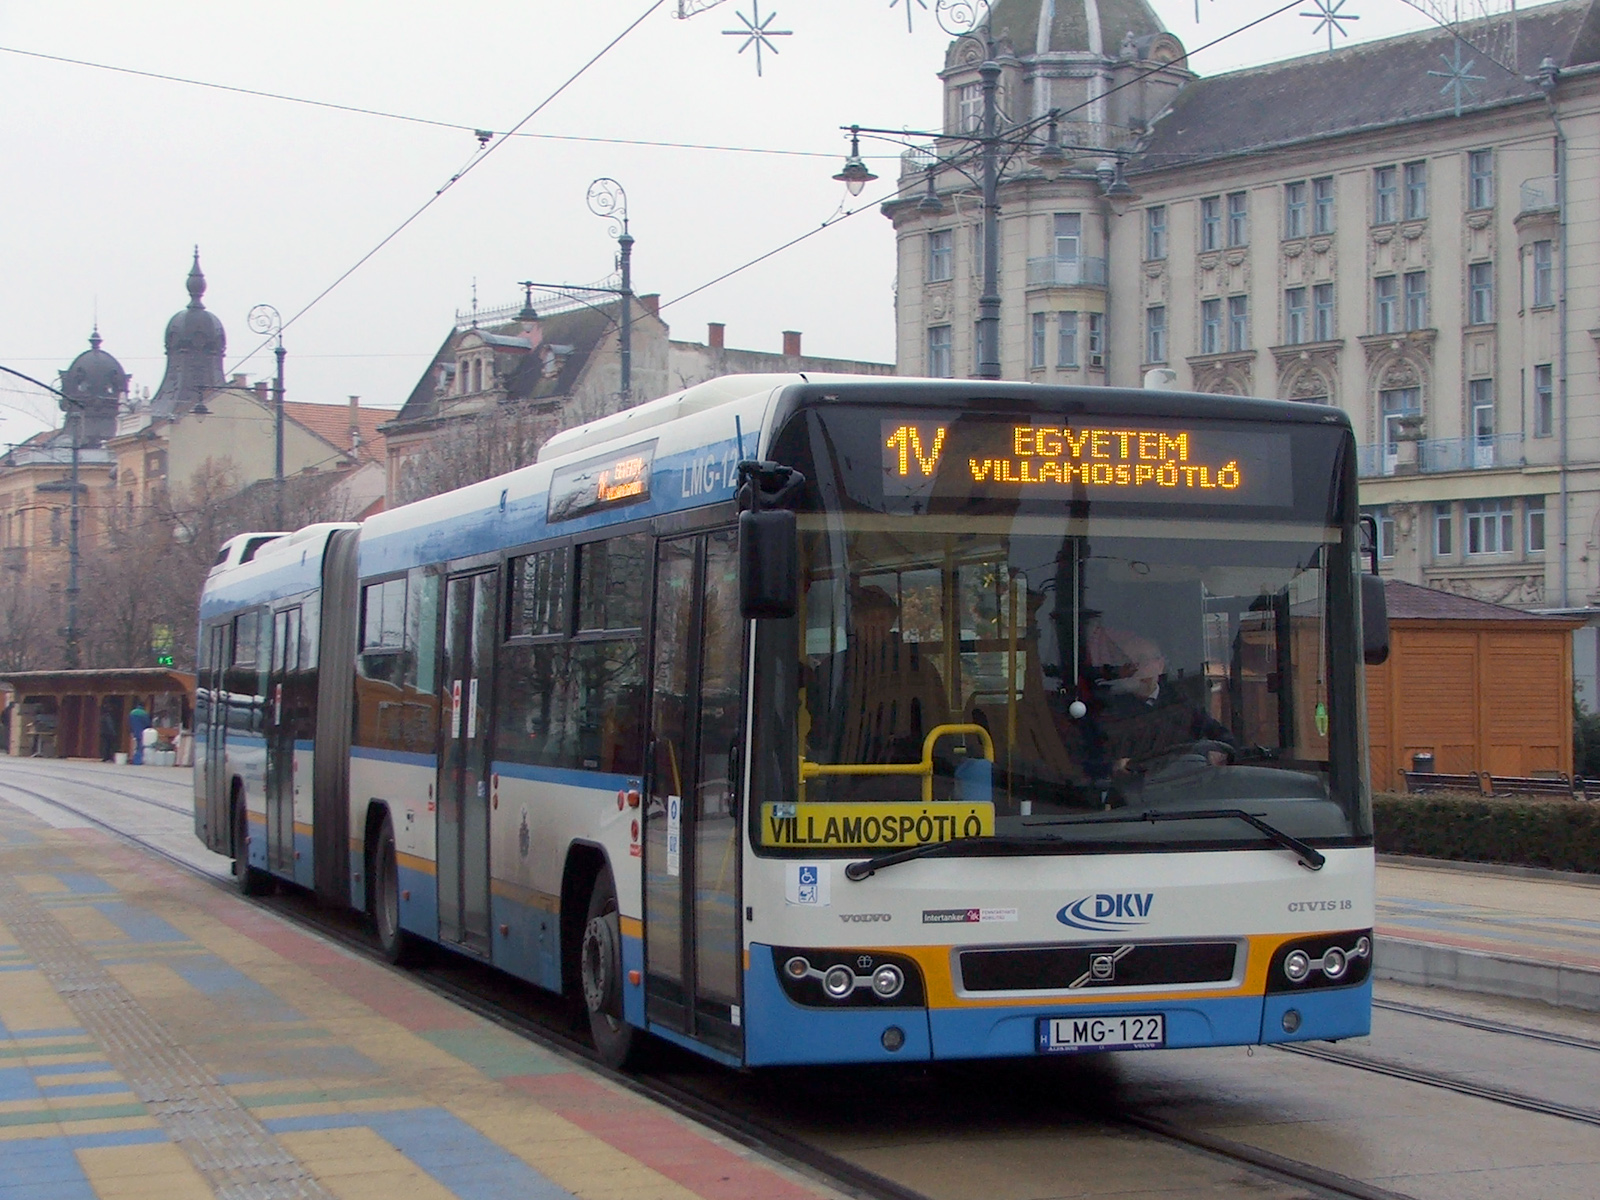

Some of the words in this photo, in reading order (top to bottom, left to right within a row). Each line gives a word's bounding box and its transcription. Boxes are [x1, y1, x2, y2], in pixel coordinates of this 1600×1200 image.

[886, 426, 945, 476] 1V
[1013, 427, 1189, 461] EGYETEM
[969, 458, 1240, 489] VILLAMOSPÓTLÓ
[839, 913, 892, 922] VOLVO
[1095, 893, 1154, 917] DKV
[1288, 901, 1336, 912] CIVIS
[1339, 900, 1352, 910] 18
[1056, 1018, 1159, 1043] LMG-122
